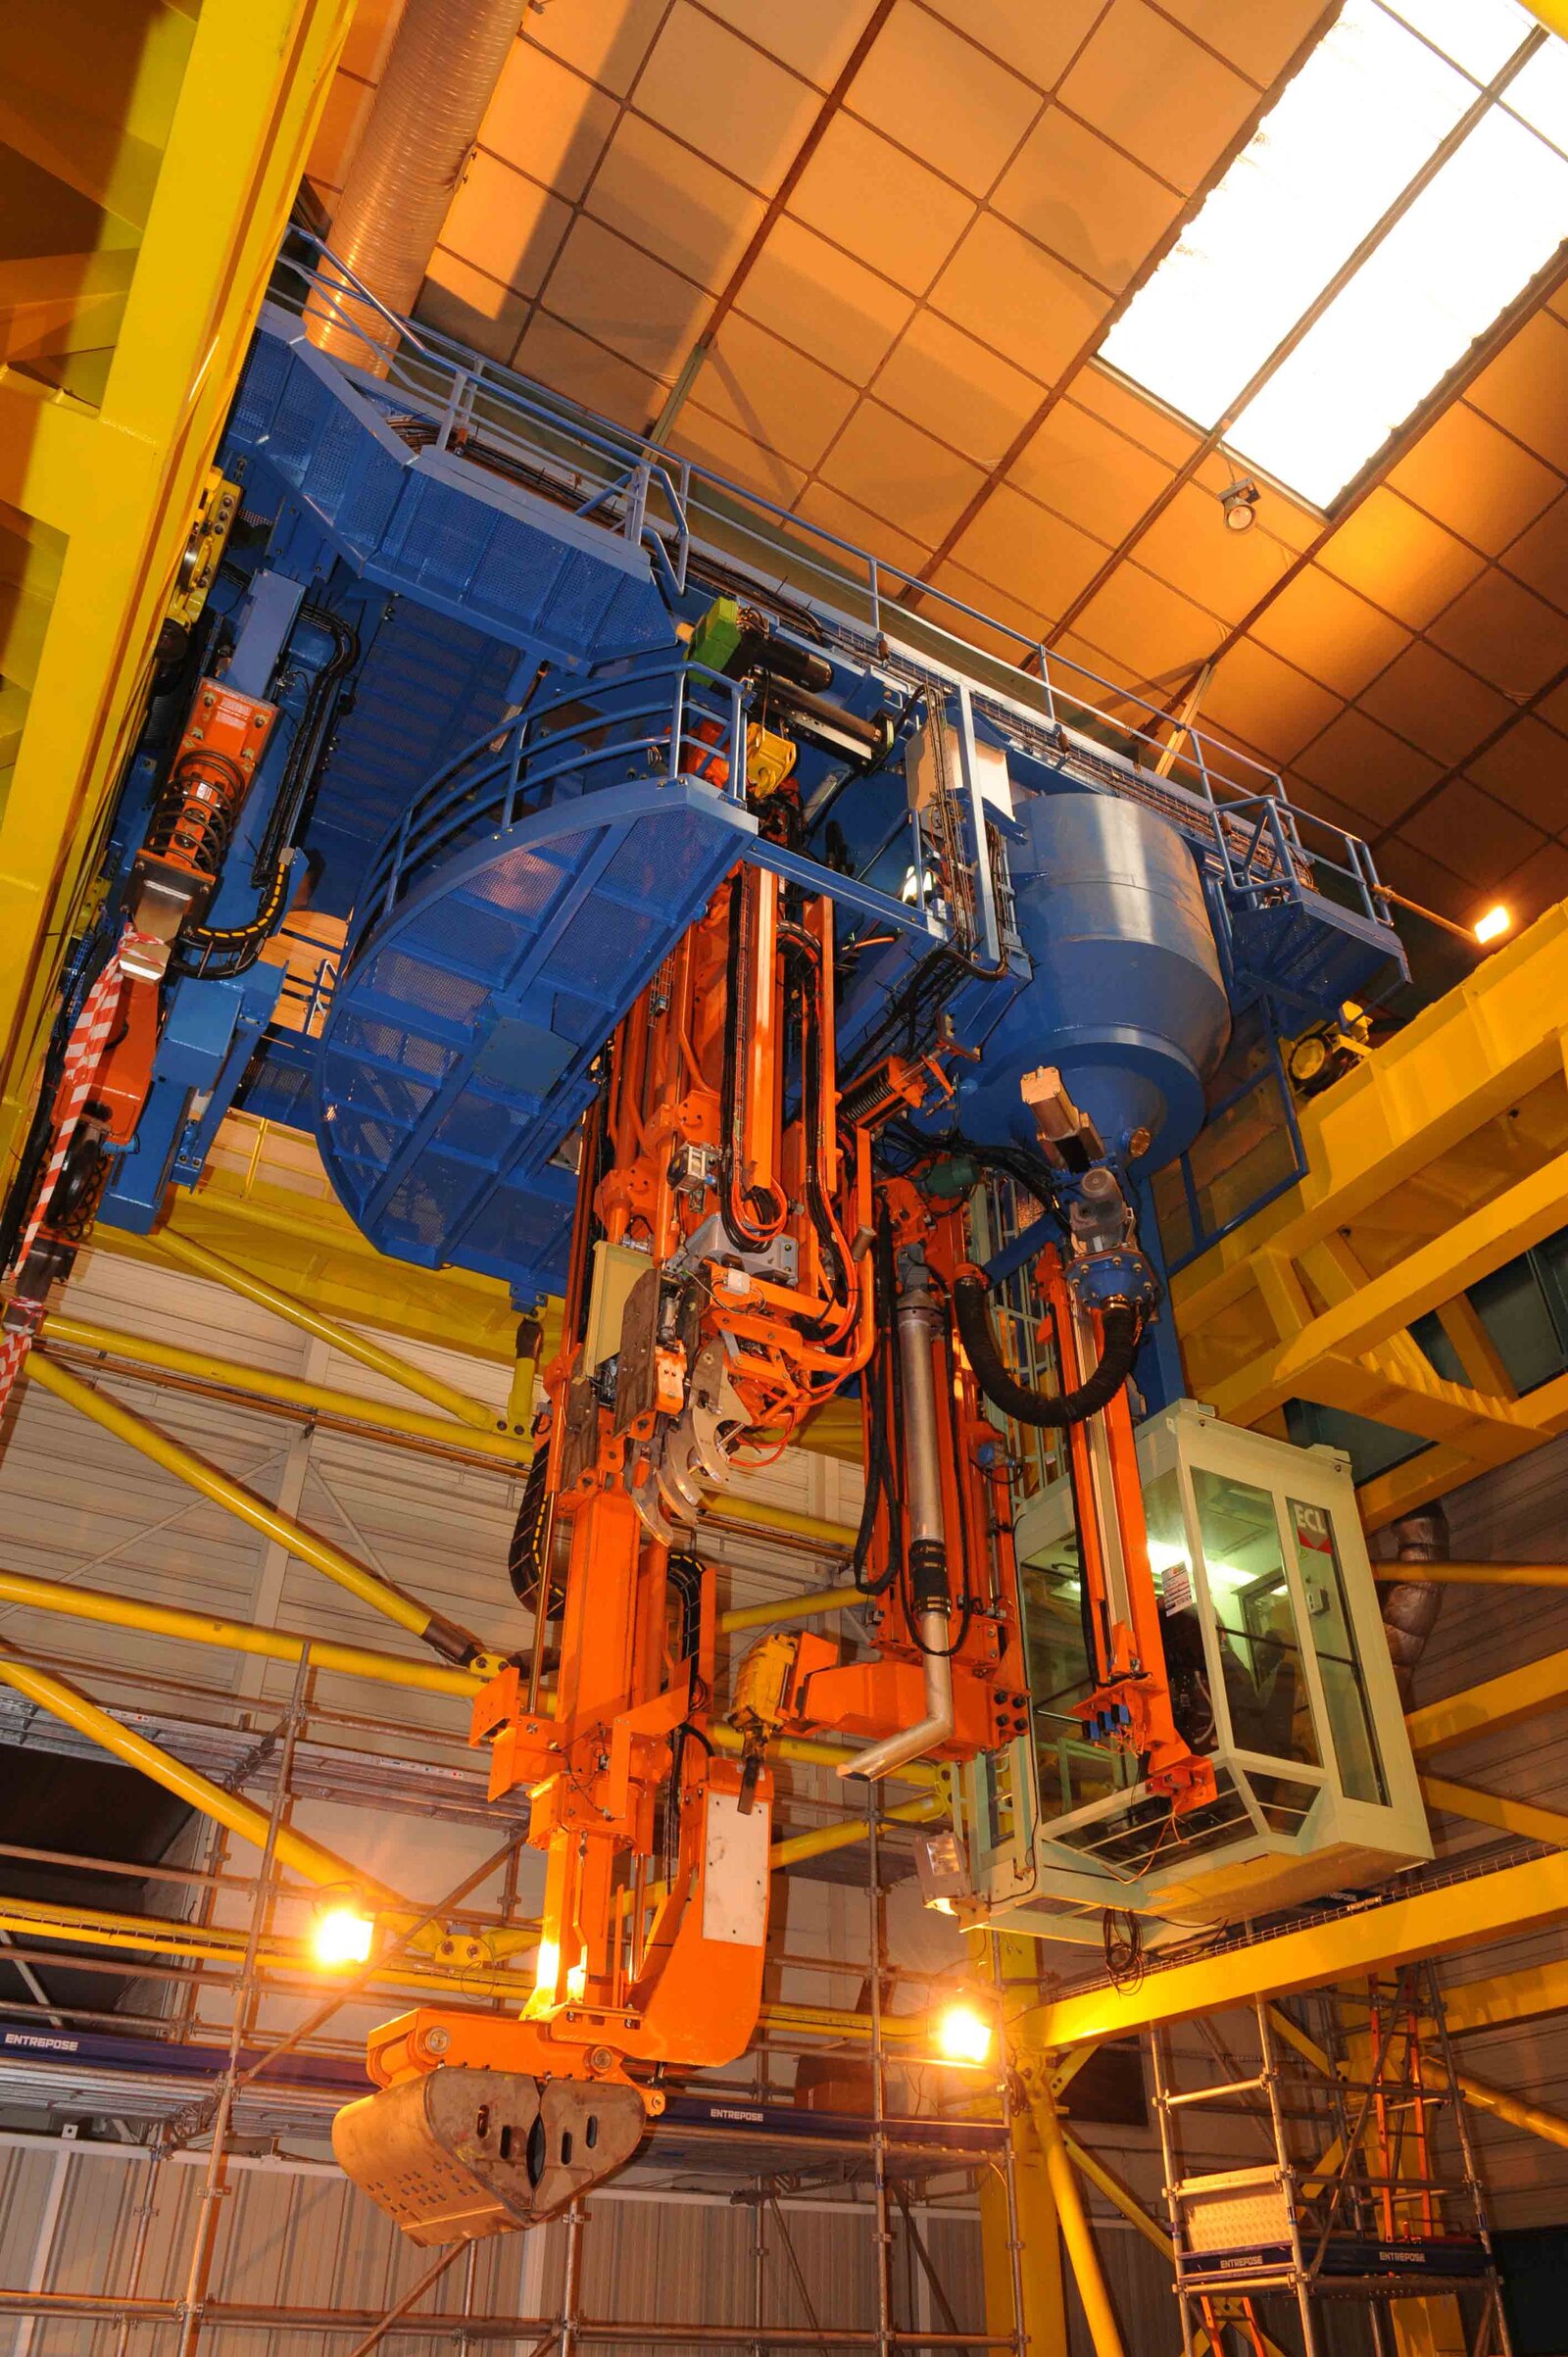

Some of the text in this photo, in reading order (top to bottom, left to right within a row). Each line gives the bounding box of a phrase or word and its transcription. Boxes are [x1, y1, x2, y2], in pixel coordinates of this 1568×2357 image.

[1294, 1503, 1327, 1535] ECL
[5, 2033, 78, 2051] ENTREPOSE
[710, 2108, 763, 2122] ENTREPOSE
[1220, 2255, 1263, 2269] ENTREPOSE
[1379, 2251, 1426, 2263] ENTREPOSE
